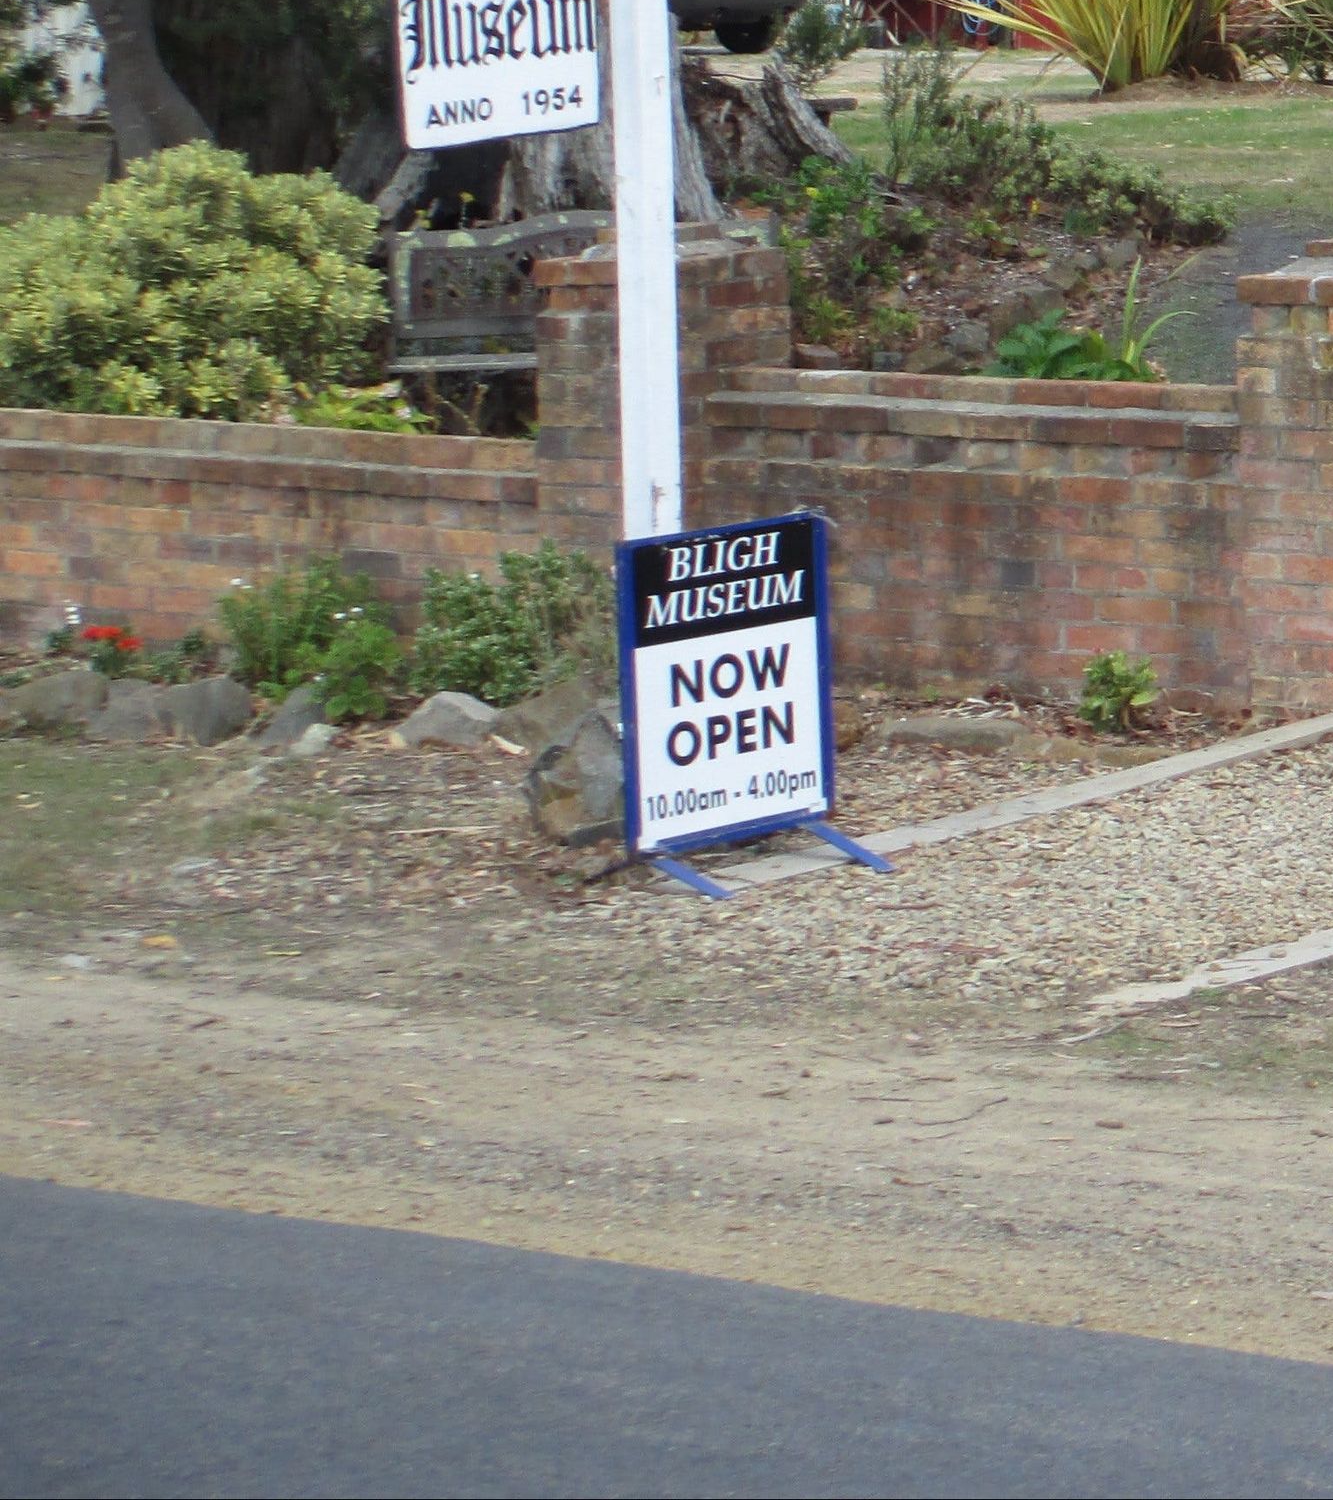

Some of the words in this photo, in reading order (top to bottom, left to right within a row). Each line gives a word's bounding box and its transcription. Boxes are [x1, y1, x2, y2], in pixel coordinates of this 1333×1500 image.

[425, 97, 494, 130] ANNO
[521, 85, 584, 116] 1954
[667, 531, 782, 583] BLIGH
[644, 569, 806, 630] MUSEUM
[669, 642, 791, 708] NOW
[666, 700, 795, 767] OPEN
[647, 787, 728, 821] 10.00am
[747, 768, 817, 800] 4.00pm
